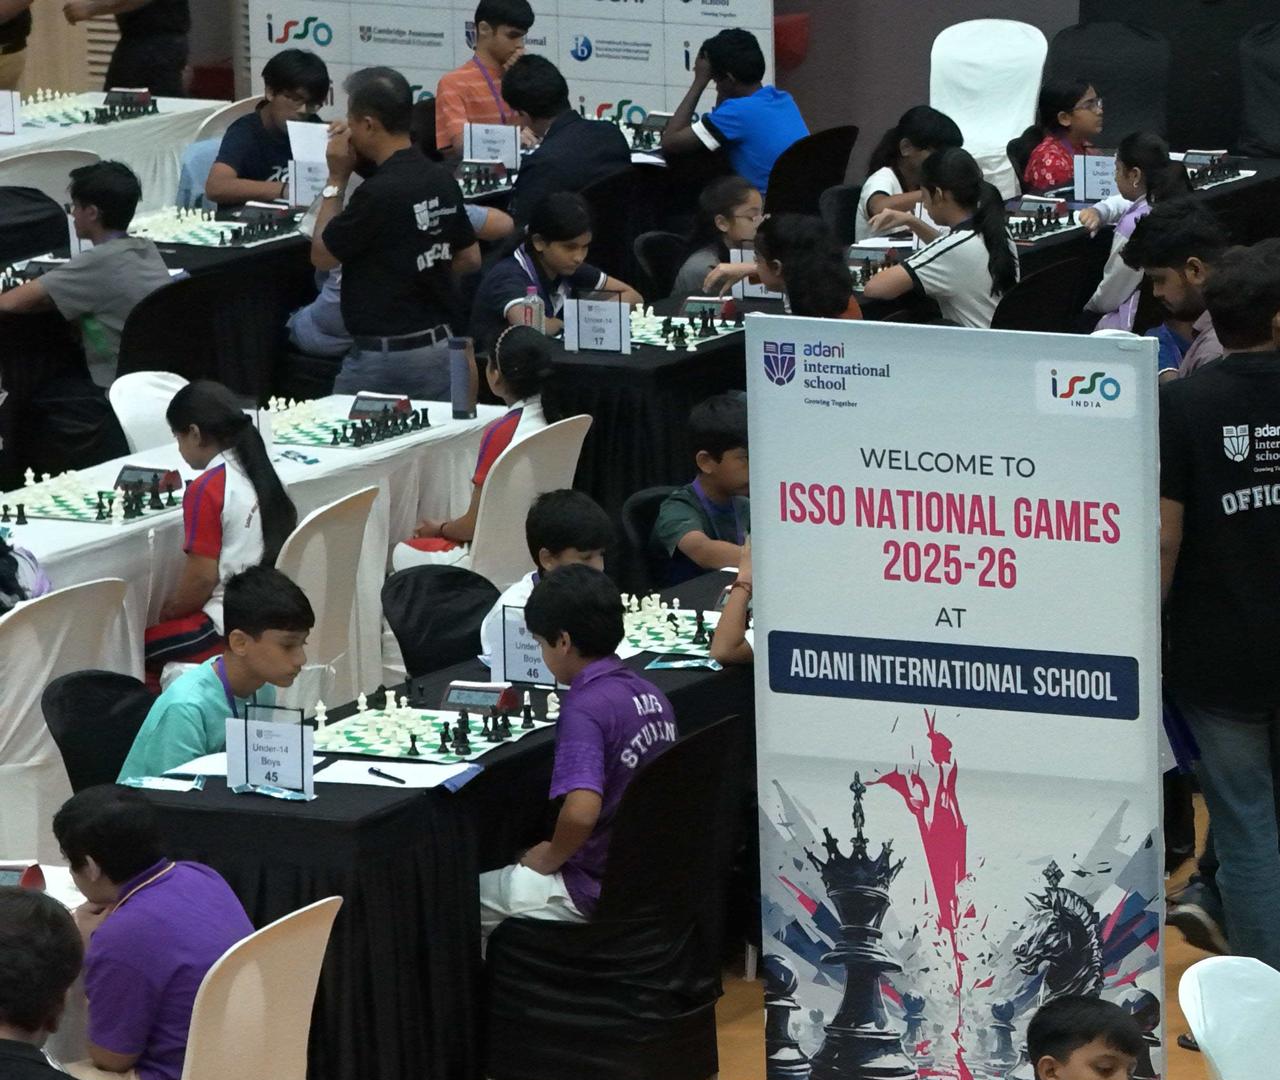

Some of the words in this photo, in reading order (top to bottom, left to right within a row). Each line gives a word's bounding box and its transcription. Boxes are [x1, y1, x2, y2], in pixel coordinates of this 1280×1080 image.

[803, 341, 845, 359] adani
[803, 360, 891, 379] international
[804, 376, 846, 392] school
[1050, 368, 1121, 402] isso
[804, 397, 830, 407] Growing
[831, 399, 858, 409] Together
[1071, 400, 1102, 409] INDIA
[860, 447, 994, 476] WELCOME
[1000, 456, 1036, 478] TO
[780, 481, 846, 527] ISSO
[855, 486, 1005, 537] NATIONAL
[1014, 496, 1121, 545] GAMES
[883, 539, 1017, 589] 2025-26
[935, 607, 967, 628] AT
[527, 668, 539, 678] 46
[790, 648, 855, 682] ADANI
[860, 654, 1028, 695] INTERNATIONAL
[1033, 666, 1118, 702] SCHOOL
[253, 744, 289, 754] Under-14
[262, 757, 281, 767] Boys
[265, 772, 279, 782] 45
